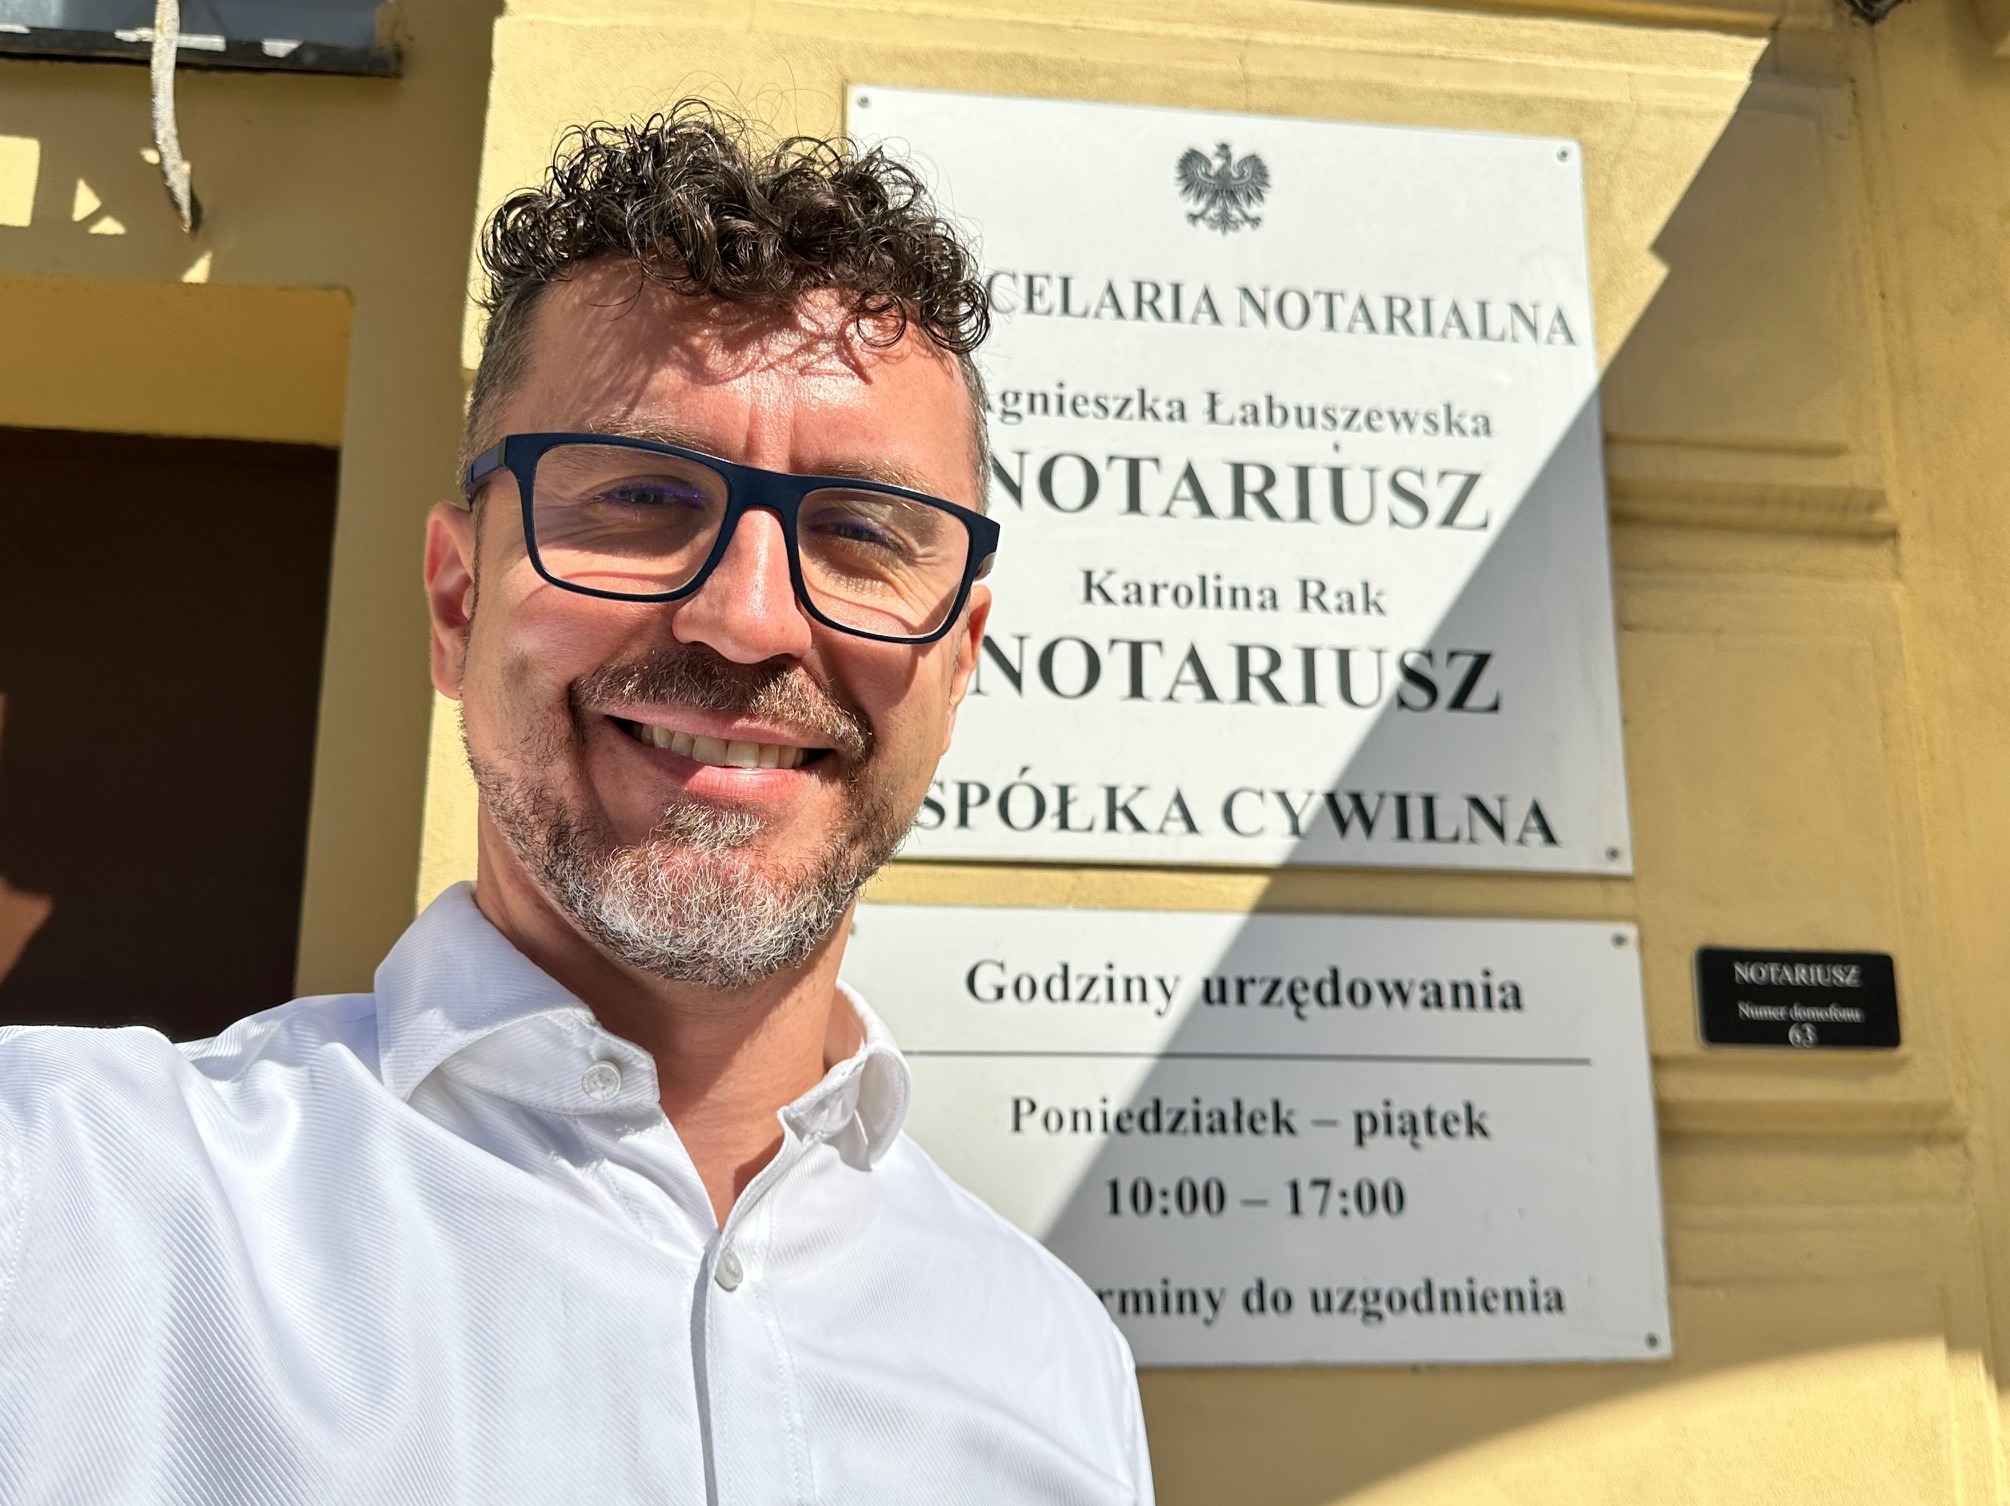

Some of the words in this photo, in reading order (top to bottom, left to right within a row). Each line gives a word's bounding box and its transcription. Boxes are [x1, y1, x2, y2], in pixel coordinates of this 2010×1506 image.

[1236, 285, 1577, 347] NOTARIALNA
[987, 381, 1189, 426] gnieszka
[1204, 391, 1493, 439] Łabuszewska
[1080, 568, 1280, 613] Karolina
[1296, 577, 1388, 617] Rak
[969, 634, 1502, 715] NOTARIUSZ
[916, 766, 1202, 836] SPÓŁKA
[1220, 786, 1562, 848] CYWILNA
[964, 959, 1182, 1018] Godziny
[1202, 965, 1525, 1022] urzędowania
[1733, 961, 1863, 987] NOTARIUSZ
[1736, 1000, 1789, 1021] Numer
[1010, 1095, 1299, 1138] Poniedziałek
[1352, 1099, 1493, 1151] piątek
[1106, 1177, 1228, 1219] 10:00
[1286, 1177, 1408, 1219] 17:00
[1240, 1276, 1295, 1317] do
[1308, 1277, 1566, 1323] uzgodnienia
